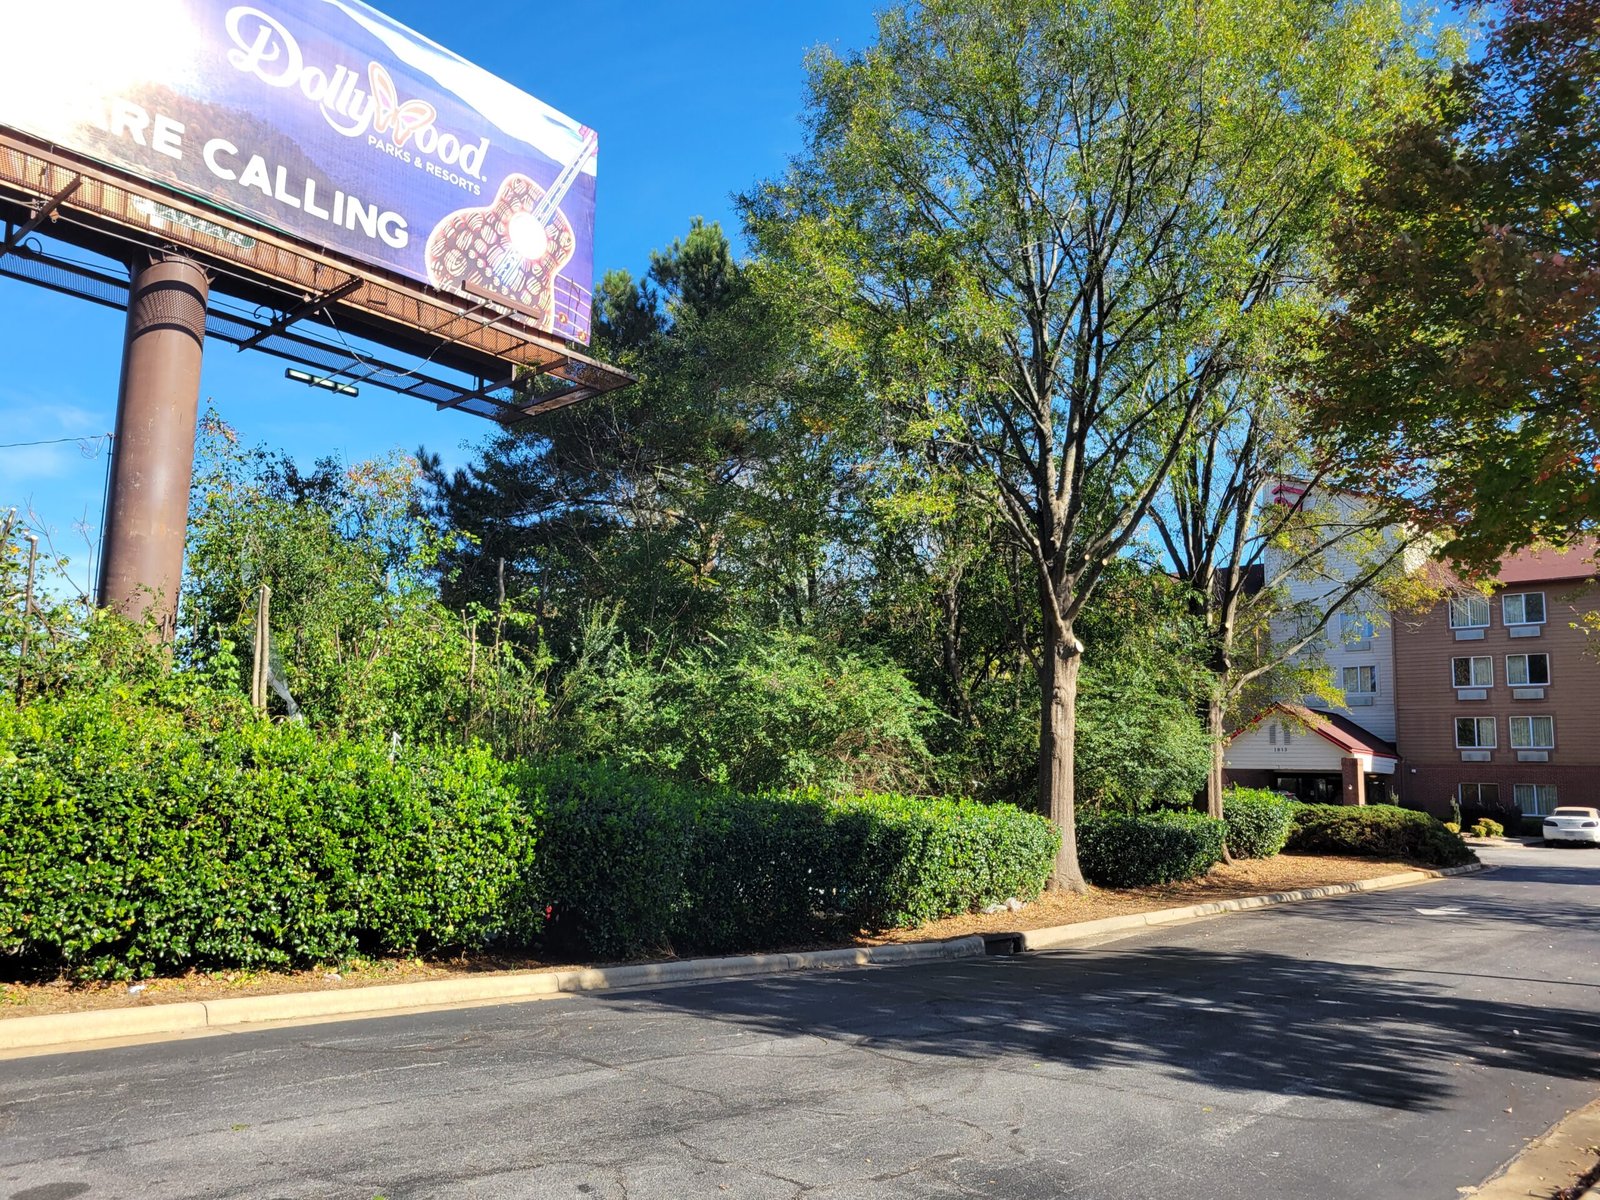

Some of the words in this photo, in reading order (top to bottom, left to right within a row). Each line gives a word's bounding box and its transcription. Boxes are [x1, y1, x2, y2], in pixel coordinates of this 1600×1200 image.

[203, 138, 409, 249] CALLING
[368, 134, 411, 165] PARKS
[414, 156, 423, 169] &
[426, 161, 481, 196] RESORTS
